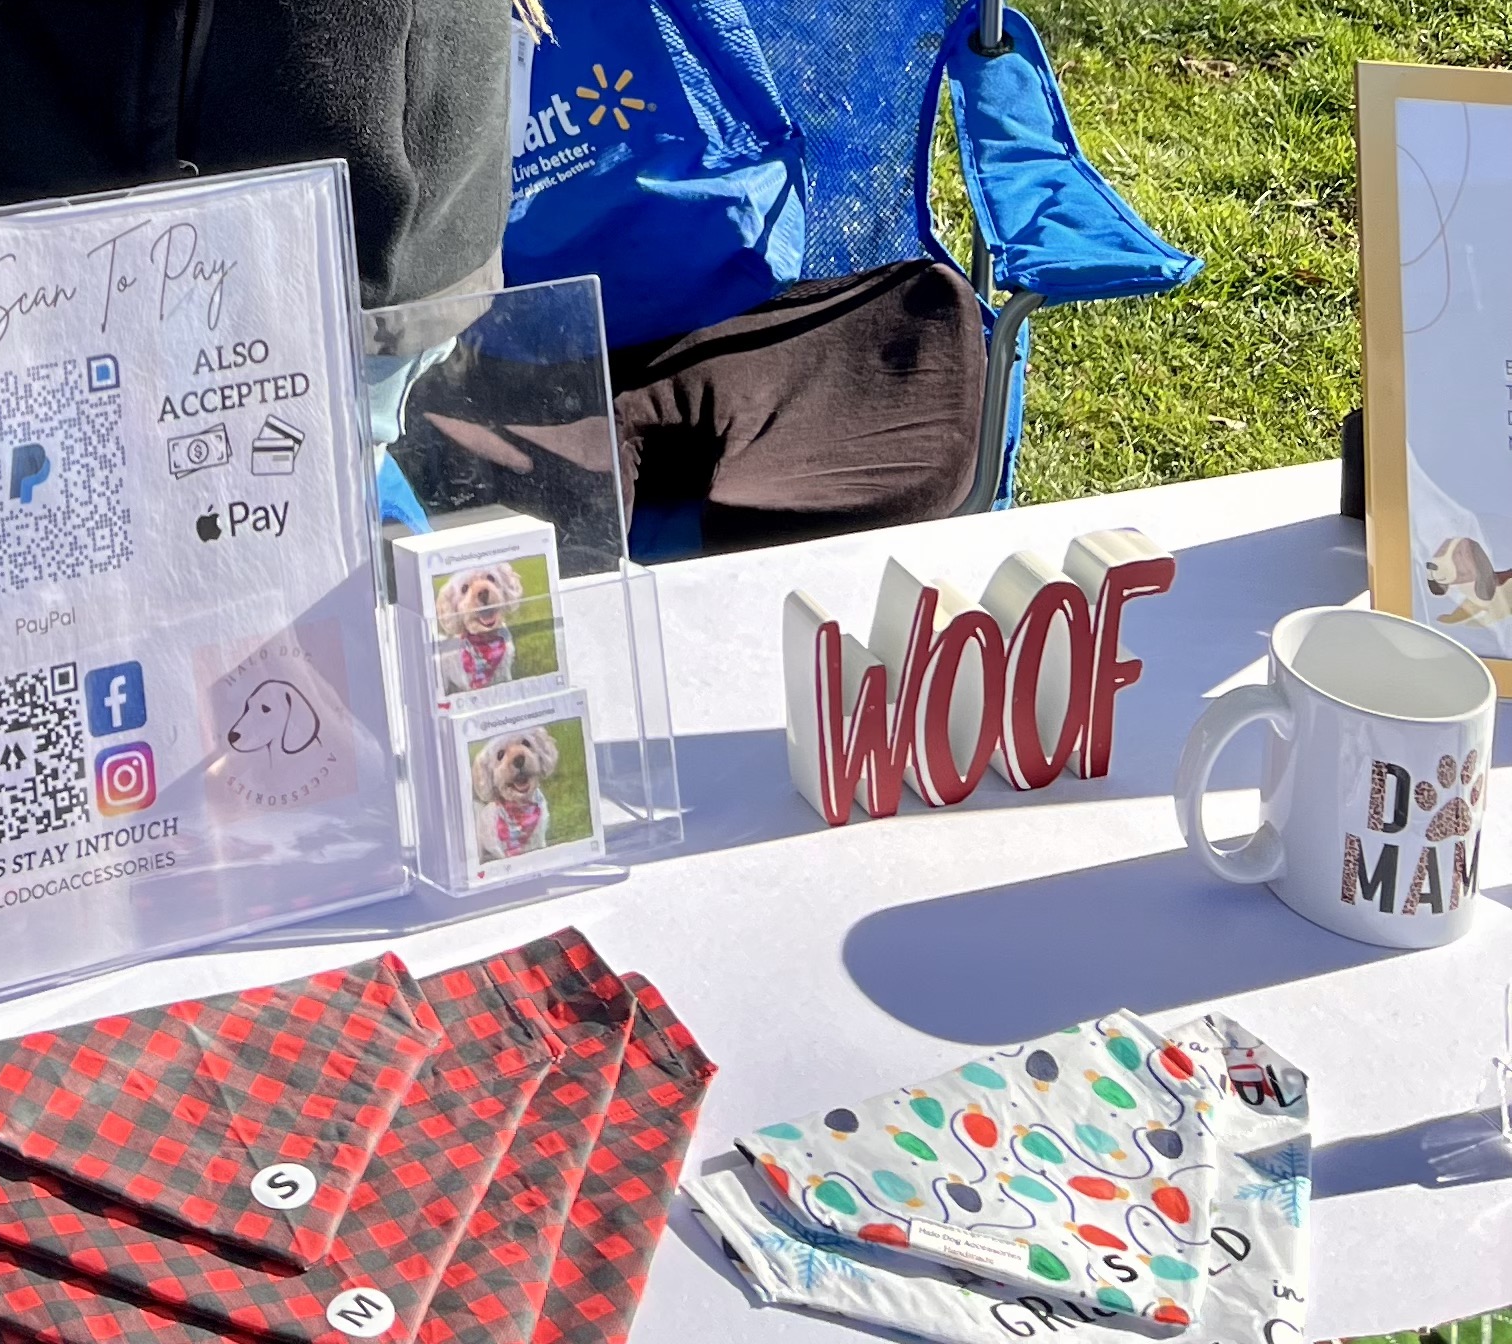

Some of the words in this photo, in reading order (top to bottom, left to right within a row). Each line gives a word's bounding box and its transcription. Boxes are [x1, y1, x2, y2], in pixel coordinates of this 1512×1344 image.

[522, 93, 581, 152] art
[512, 163, 540, 183] Live
[538, 142, 597, 172] better.
[555, 158, 597, 183] bottles
[87, 219, 153, 332] To
[149, 222, 239, 330] Pay
[192, 339, 270, 376] ALSO
[157, 371, 311, 422] ACCEPTED
[229, 500, 290, 537] Pay
[15, 607, 76, 637] PayPal
[224, 649, 269, 688] HALO
[279, 645, 313, 663] DOG
[816, 557, 1175, 826] WOOF
[226, 752, 338, 807] ACCESSORIES
[11, 842, 69, 875] STAY
[76, 816, 179, 859] INTOUCH
[266, 1171, 300, 1200] S
[942, 1233, 962, 1246] Dog
[1102, 1253, 1139, 1283] S
[336, 1293, 384, 1329] M
